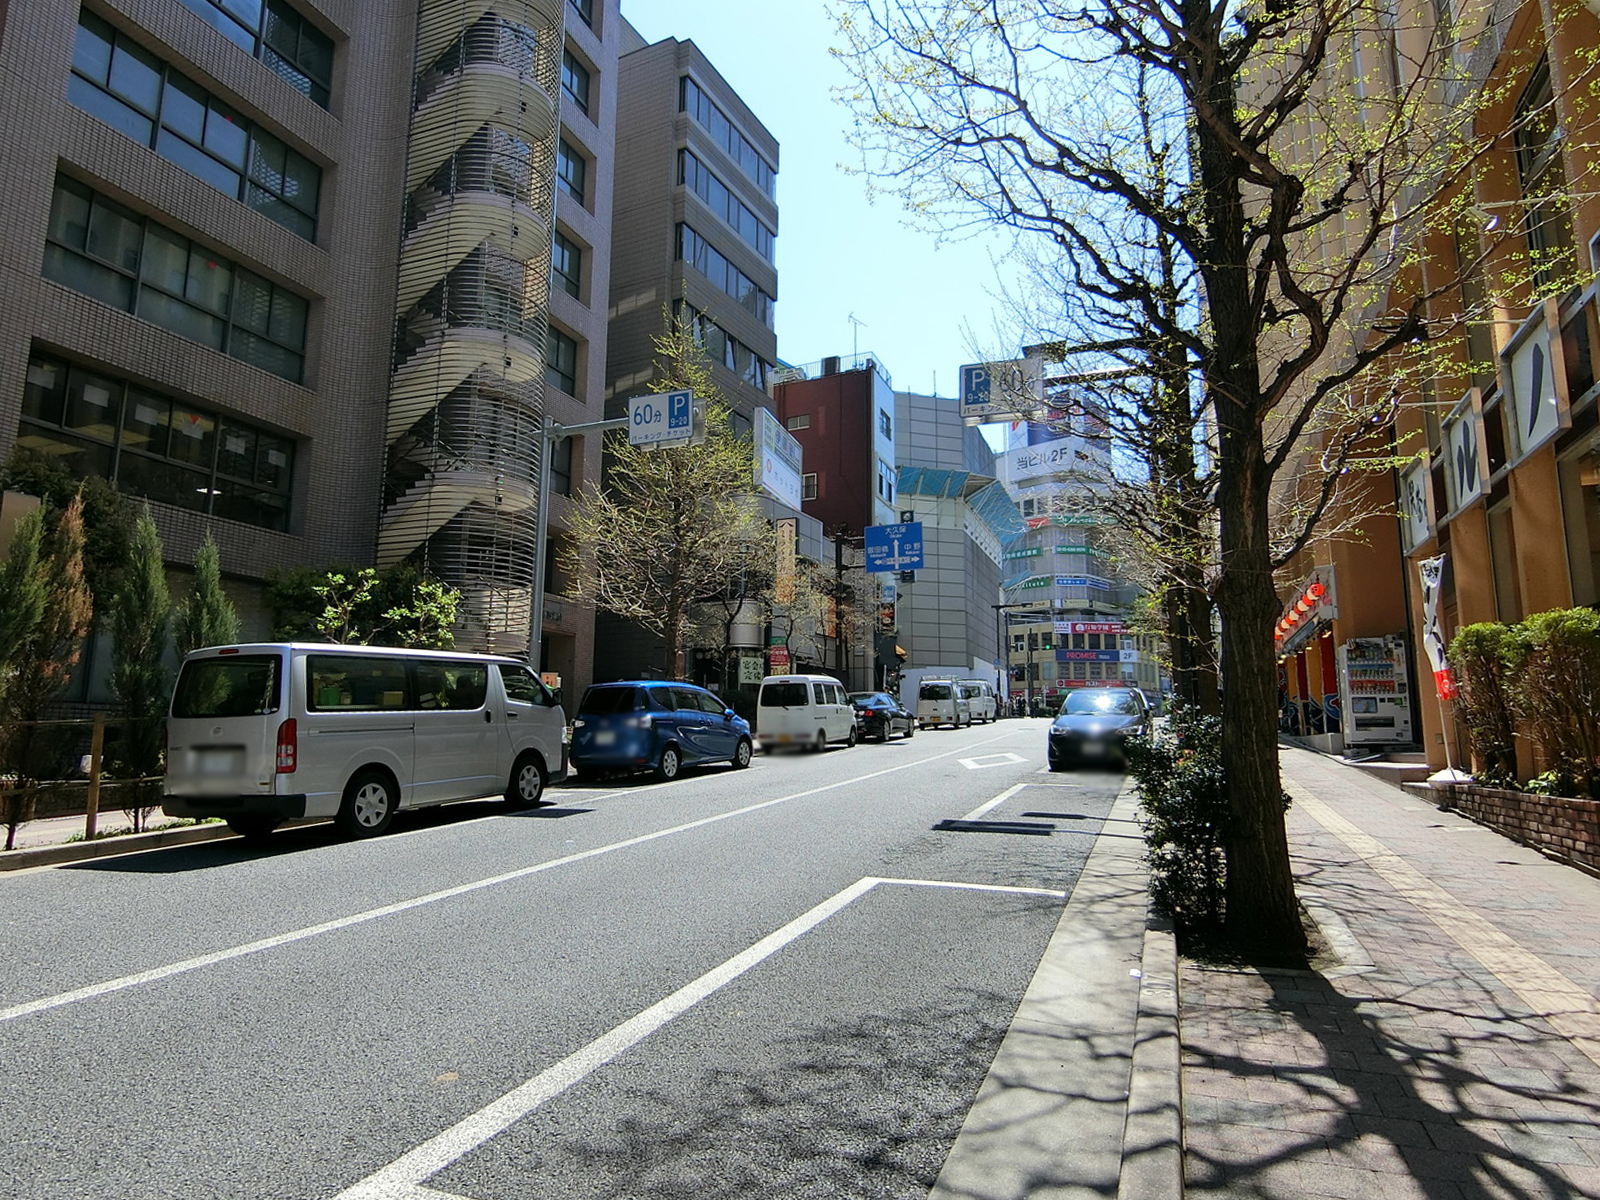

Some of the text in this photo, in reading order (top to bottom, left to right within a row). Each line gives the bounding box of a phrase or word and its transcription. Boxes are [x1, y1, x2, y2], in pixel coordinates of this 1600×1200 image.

[972, 369, 985, 391] P
[674, 396, 685, 415] P
[633, 403, 662, 426] 60分
[670, 416, 688, 427] 9-20
[1017, 447, 1067, 470] 当ビル2F
[885, 526, 906, 534] 大久保
[1066, 651, 1097, 660] PROMISE
[1123, 652, 1134, 660] 2F
